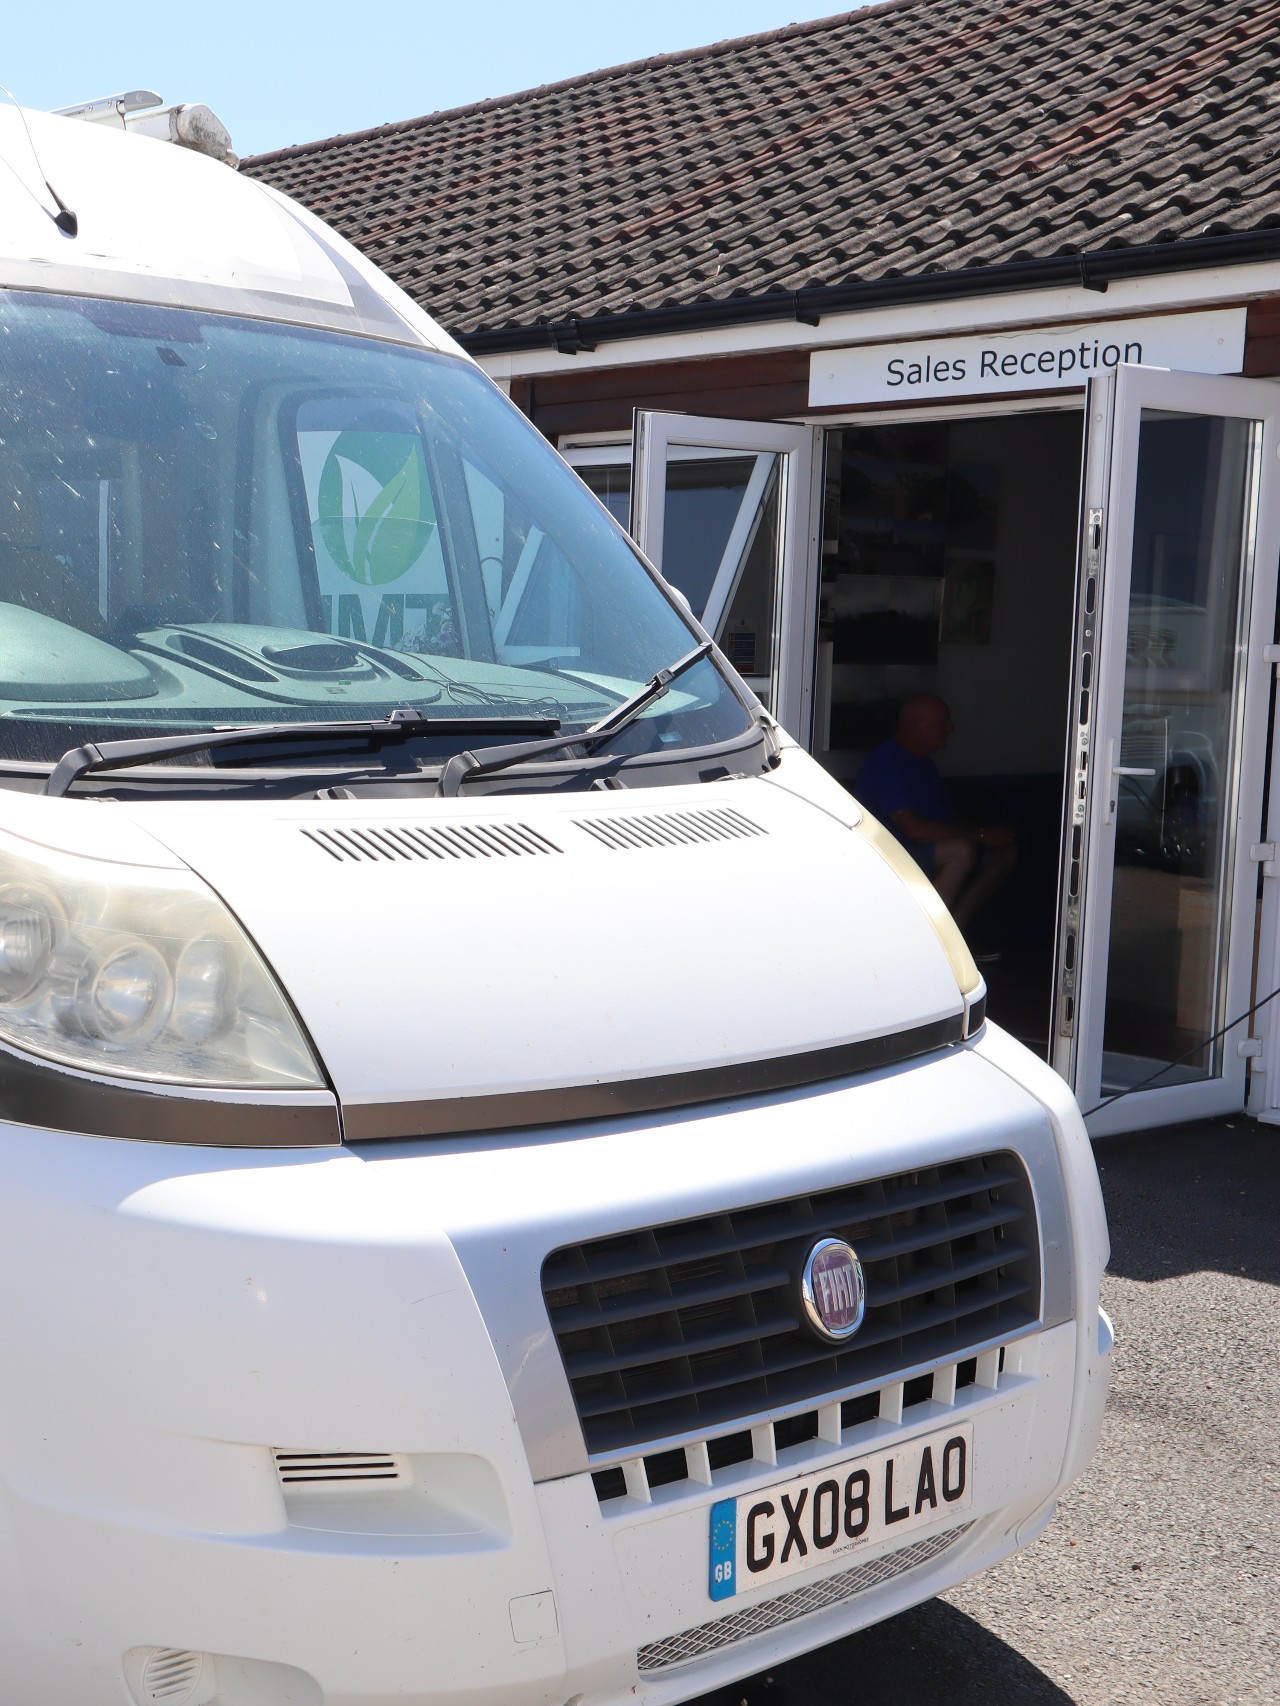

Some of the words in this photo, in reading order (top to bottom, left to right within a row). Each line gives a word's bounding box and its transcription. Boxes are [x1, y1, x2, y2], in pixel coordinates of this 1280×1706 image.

[886, 356, 966, 386] Sales
[980, 339, 1143, 378] Reception
[818, 1263, 855, 1314] FIAT
[746, 1469, 870, 1572] GX08
[714, 1560, 732, 1583] GB
